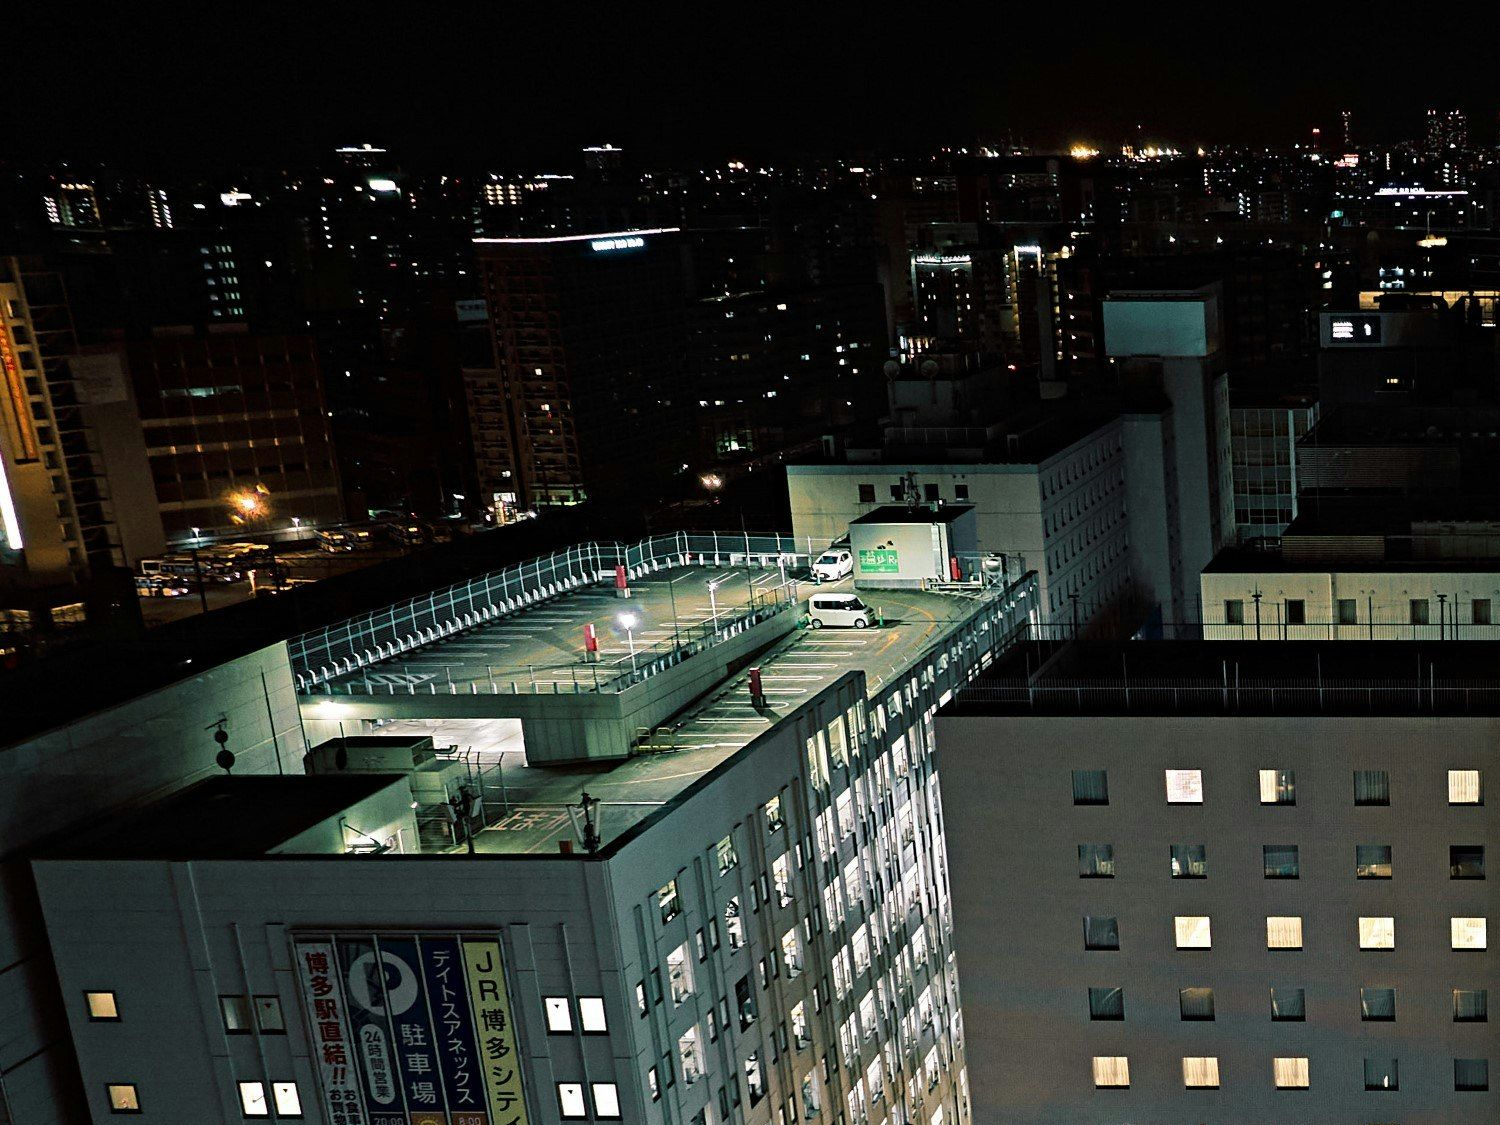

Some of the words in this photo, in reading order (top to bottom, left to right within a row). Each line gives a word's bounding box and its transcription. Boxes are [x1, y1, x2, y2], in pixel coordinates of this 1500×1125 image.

[364, 1030, 390, 1099] 24時間営業
[401, 1023, 436, 1104] 駐車場
